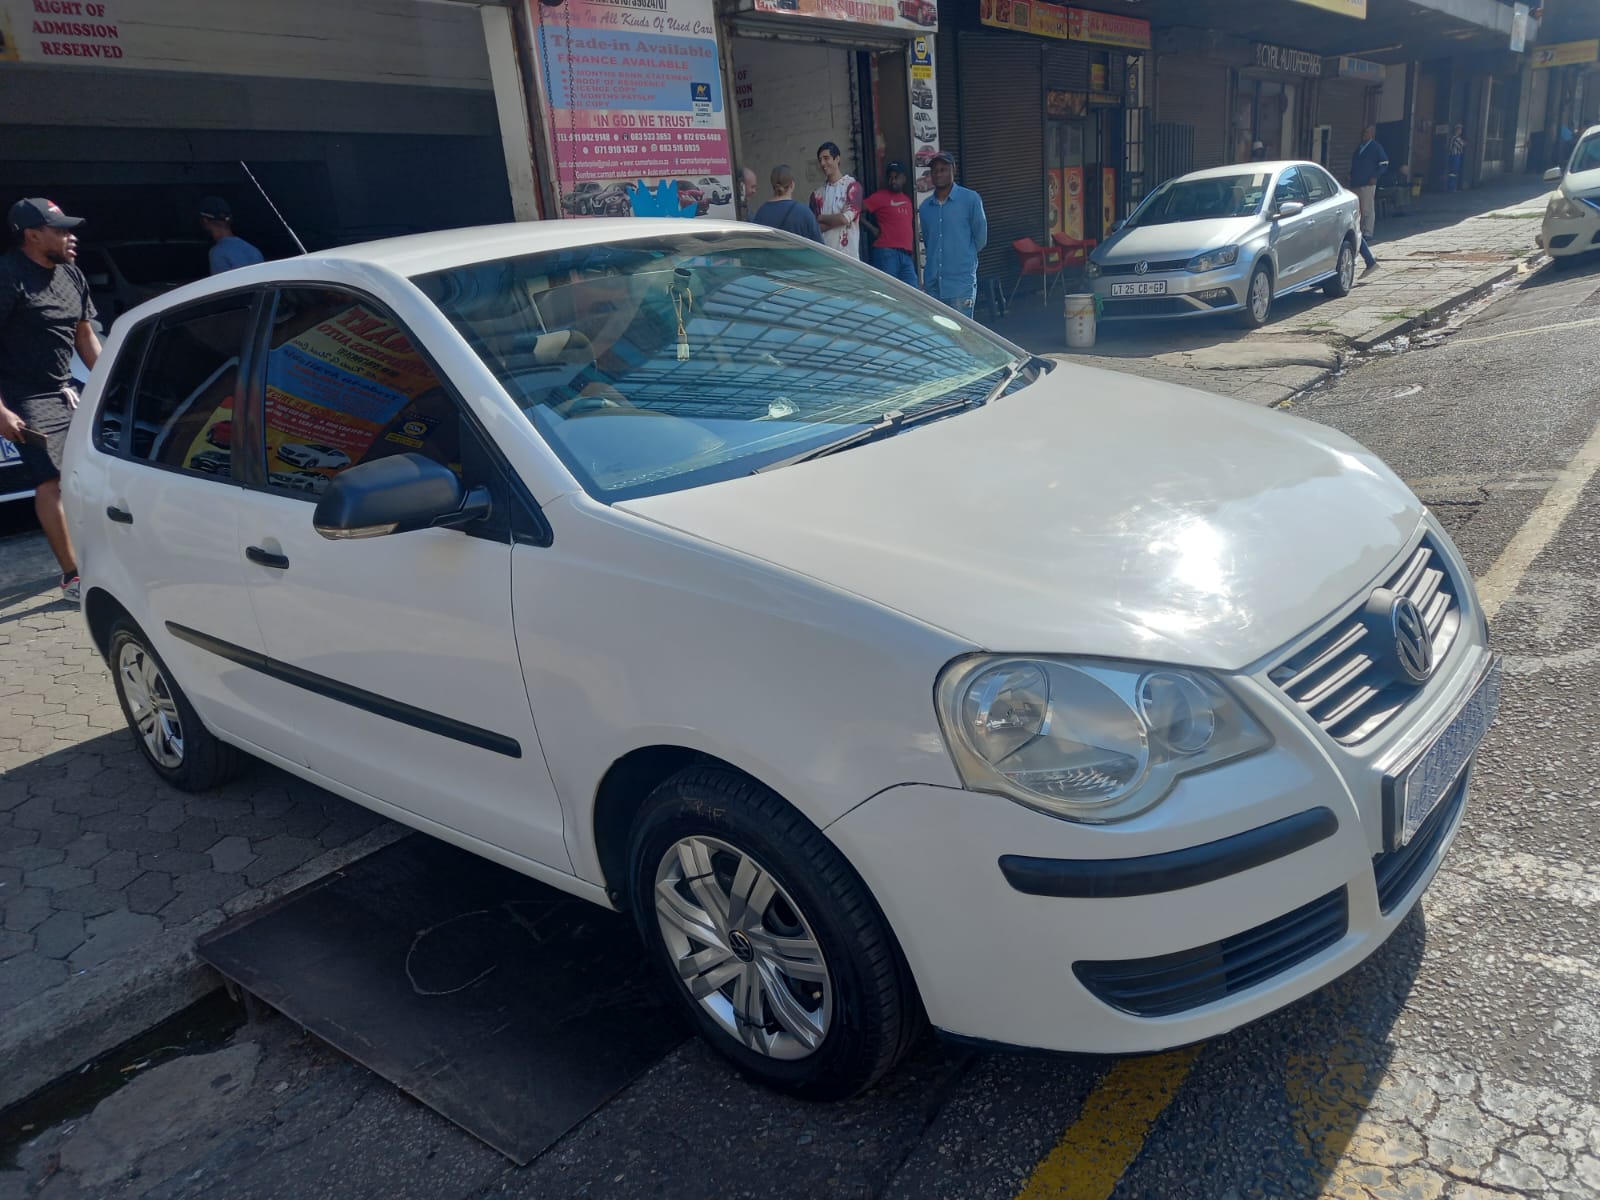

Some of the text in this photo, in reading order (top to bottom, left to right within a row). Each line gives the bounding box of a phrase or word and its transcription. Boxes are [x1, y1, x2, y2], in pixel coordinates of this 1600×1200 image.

[33, 0, 105, 17] RIGHT OF
[32, 20, 119, 38] ADMISSION
[600, 11, 618, 24] All
[621, 13, 649, 27] Kinds
[653, 15, 665, 32] Of
[667, 18, 690, 32] Used
[693, 21, 713, 34] Cars
[41, 42, 123, 58] RESERVED
[635, 41, 712, 58] Available
[622, 57, 688, 70] AVAILABLE
[613, 116, 635, 127] GOD
[640, 116, 655, 127] WE
[1125, 285, 1135, 294] 25
[1154, 283, 1163, 293] GP
